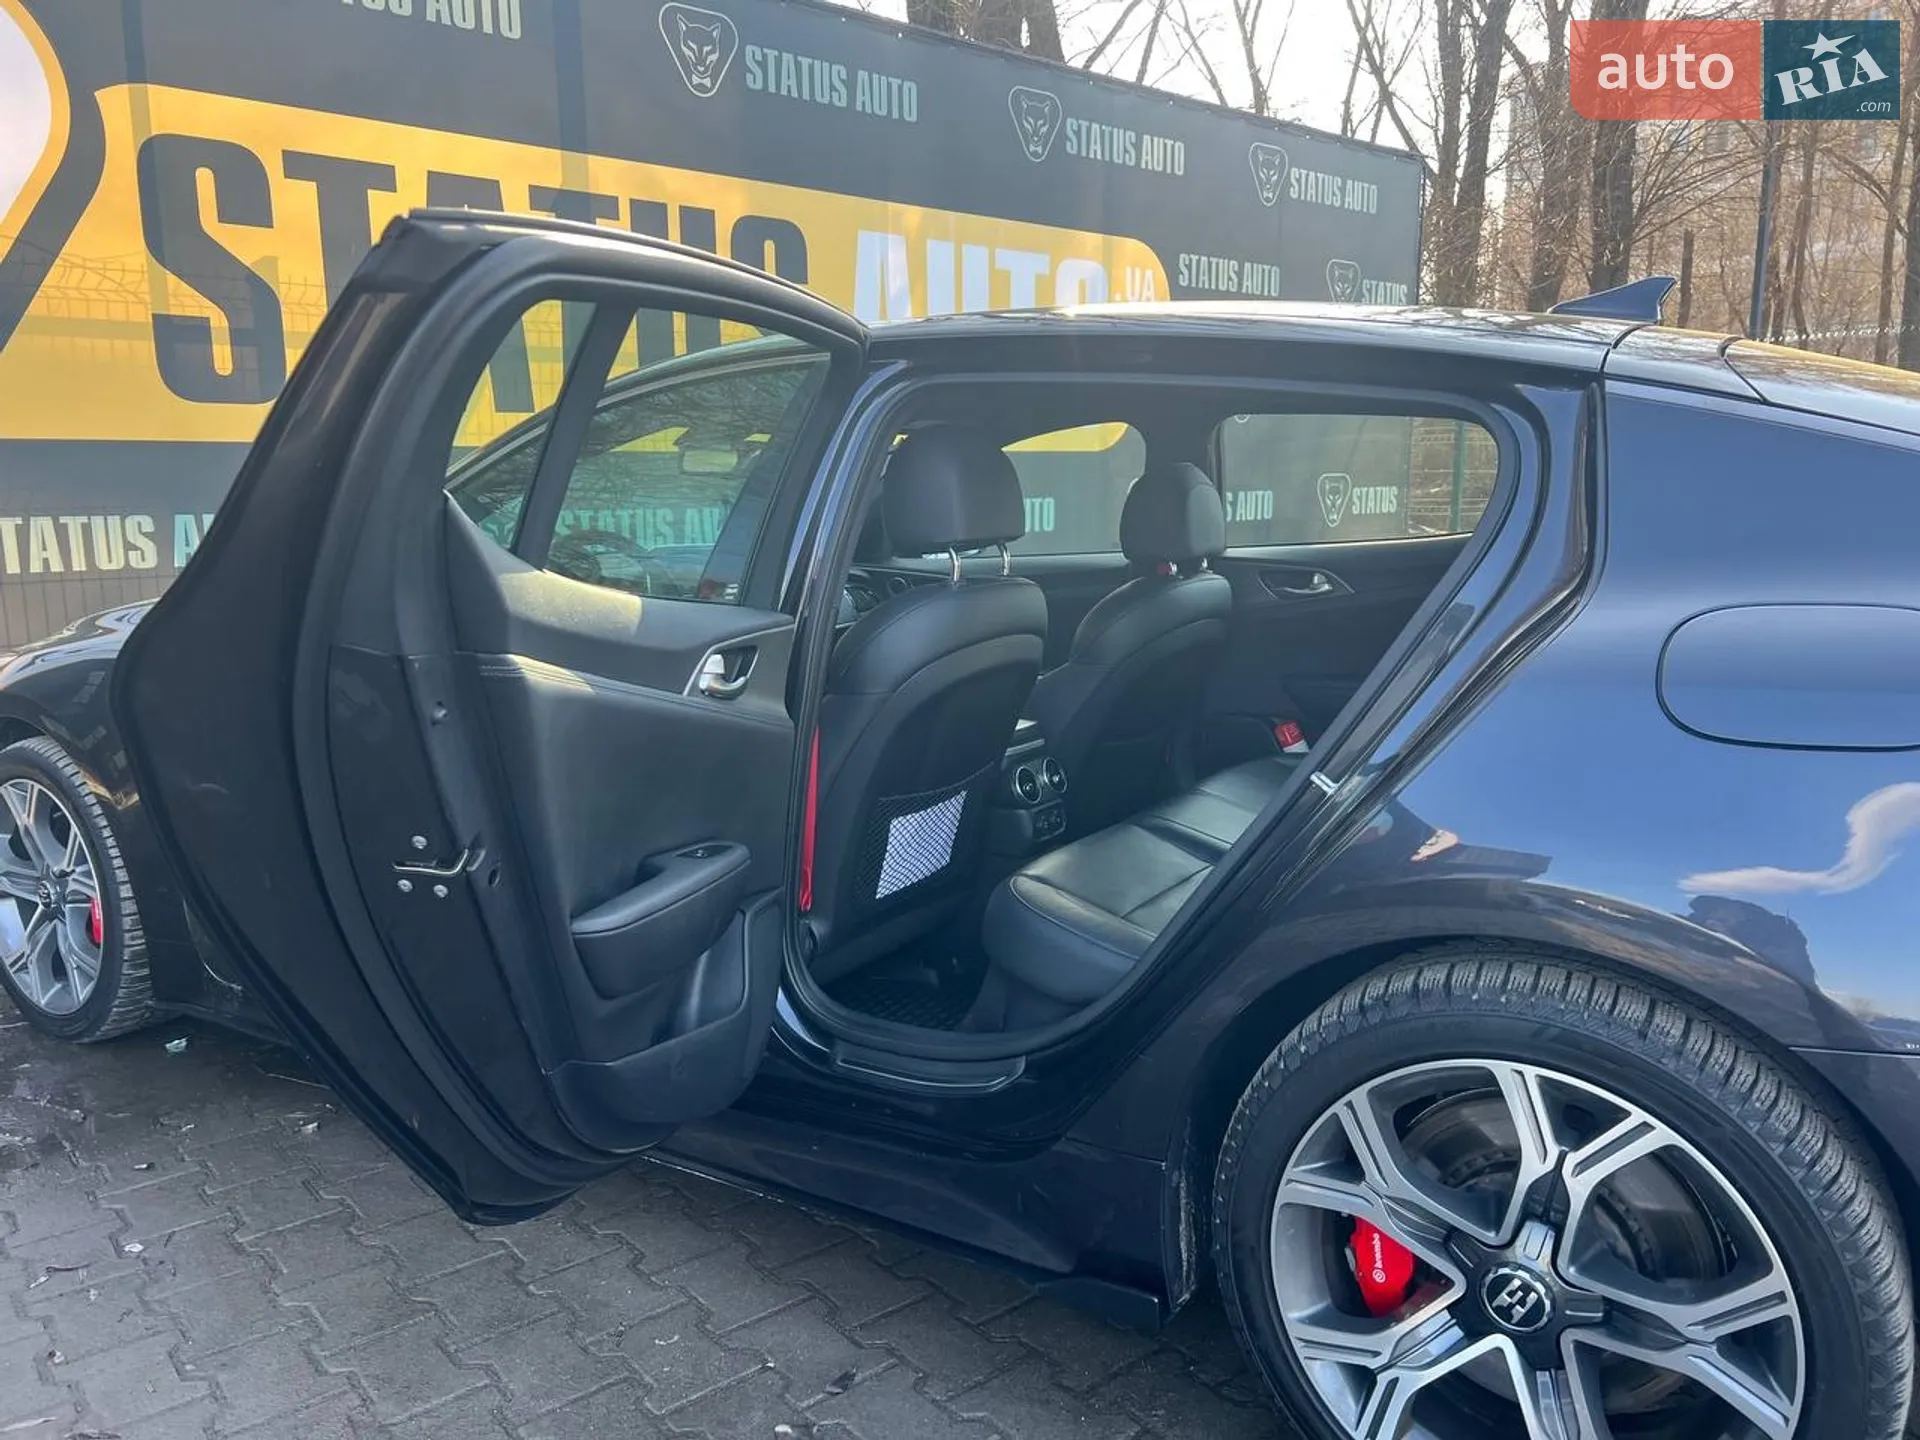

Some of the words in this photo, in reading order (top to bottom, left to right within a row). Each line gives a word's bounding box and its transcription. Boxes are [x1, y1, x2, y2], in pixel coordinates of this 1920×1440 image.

[745, 44, 848, 107] STATUS
[856, 70, 918, 122] AUTO
[1066, 118, 1136, 166] STATUS
[1141, 134, 1185, 175] AUTO
[1290, 167, 1341, 208] STATUS
[1344, 180, 1378, 214] AUTO
[1178, 253, 1238, 293] STATUS
[1241, 261, 1281, 297] AUTO
[1361, 279, 1408, 305] STATUS
[1236, 490, 1273, 522] AUTO
[1352, 486, 1398, 515] STATUS
[1372, 1232, 1383, 1270] brembo
